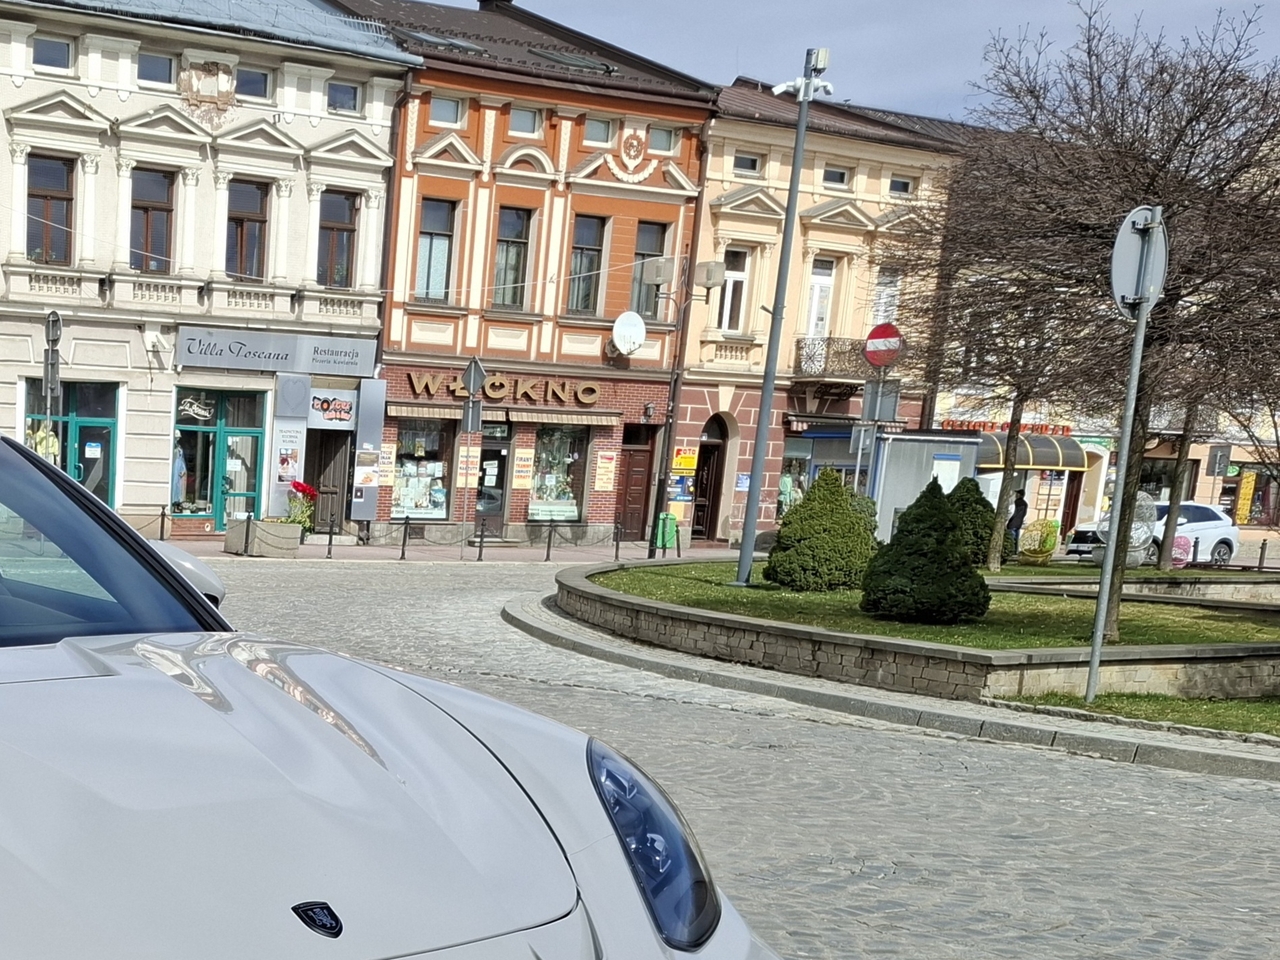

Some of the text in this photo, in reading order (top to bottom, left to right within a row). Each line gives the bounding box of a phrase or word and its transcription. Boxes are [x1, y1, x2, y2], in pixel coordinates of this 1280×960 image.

[186, 338, 289, 361] Villa Toscana
[313, 346, 360, 360] Restauracja
[675, 448, 696, 458] FOTO
